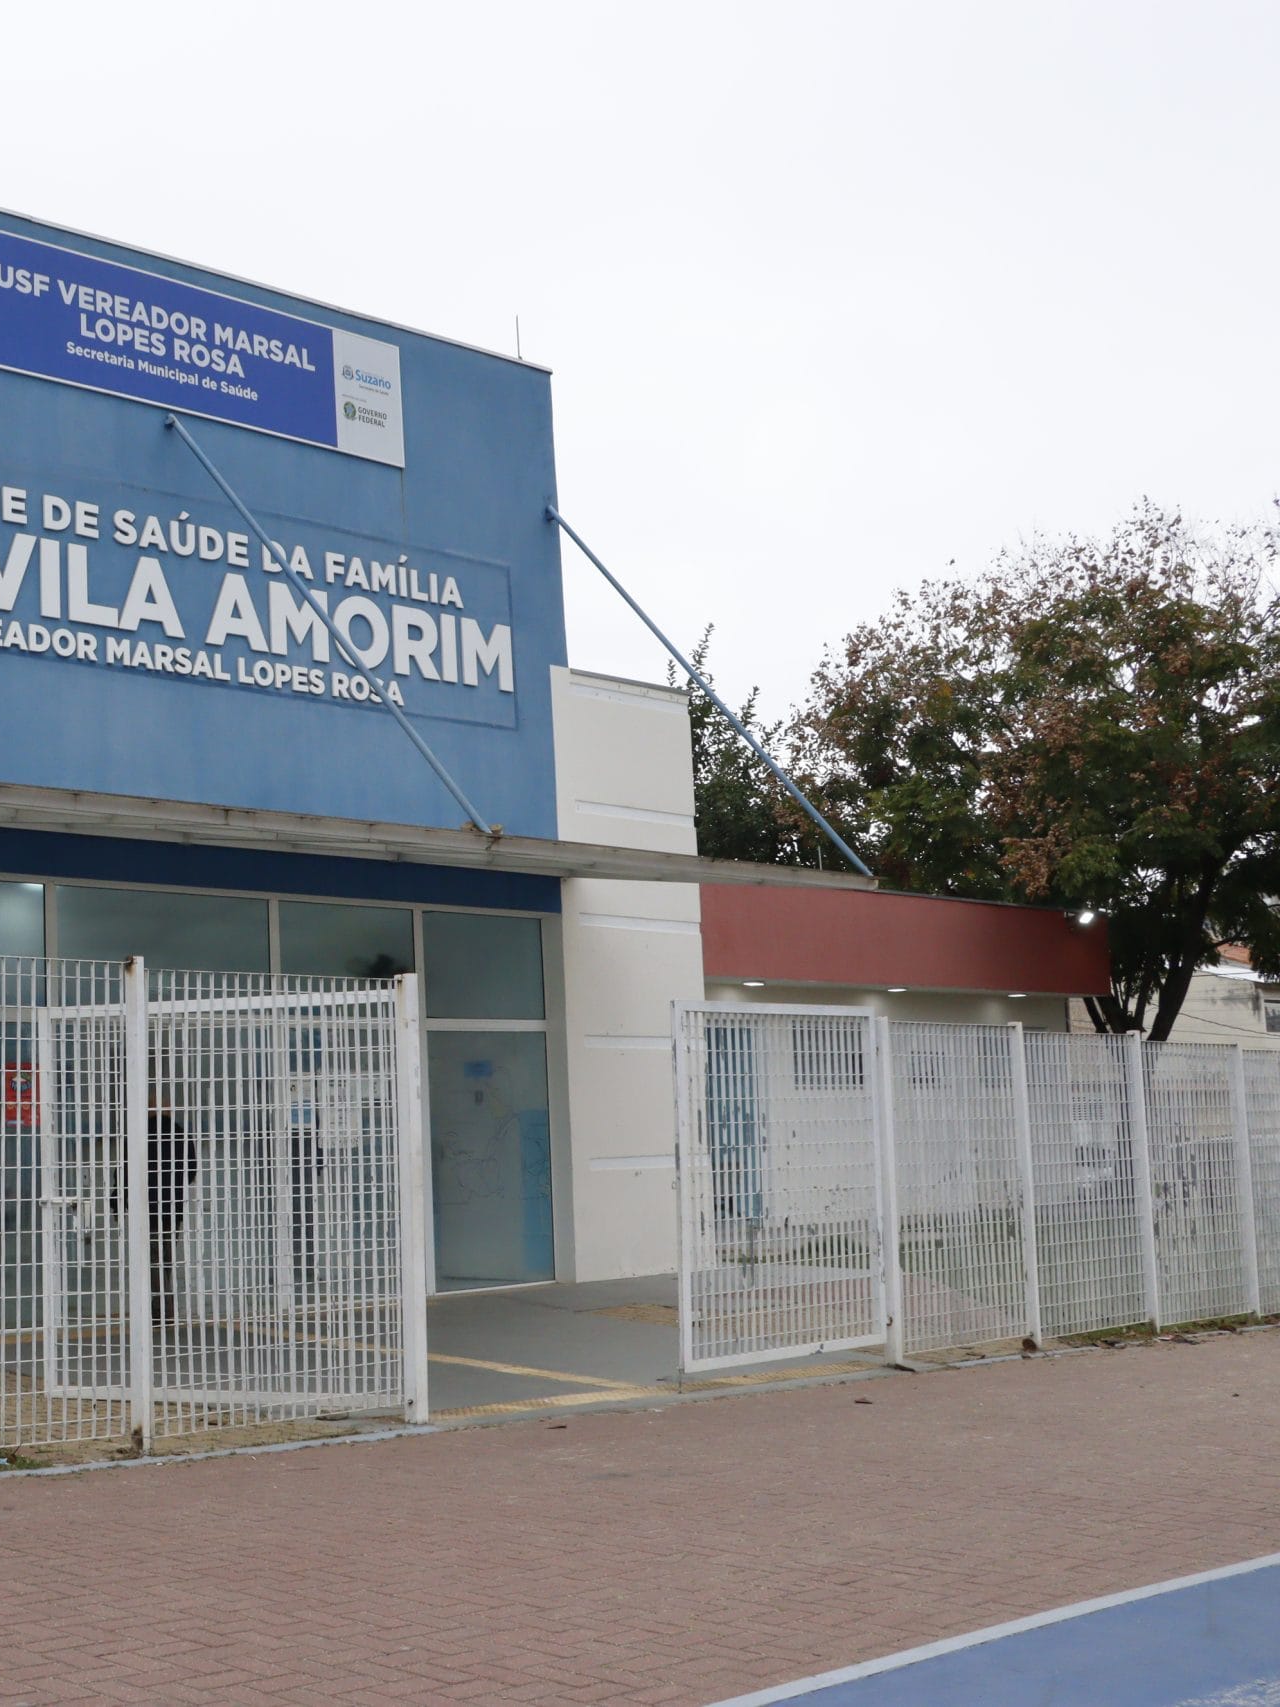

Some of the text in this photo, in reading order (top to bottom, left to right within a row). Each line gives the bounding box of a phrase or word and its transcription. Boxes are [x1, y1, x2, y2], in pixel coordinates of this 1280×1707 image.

[56, 279, 207, 342] VEREADOR
[214, 322, 316, 372] MARSAL
[79, 312, 245, 378] LOPES ROSA
[66, 341, 259, 401] Secretaria Municipal de Saúde
[355, 368, 392, 390] Suzano
[357, 406, 388, 420] GOVERNO
[358, 414, 386, 428] FEDERAL
[42, 494, 100, 539] DE
[112, 508, 250, 567] SAÚDE
[261, 539, 314, 581] DA
[324, 551, 464, 610] FAMÍLIA
[205, 572, 515, 693] AMORIM
[105, 636, 231, 682] MARSAL
[237, 656, 326, 695] LOPES
